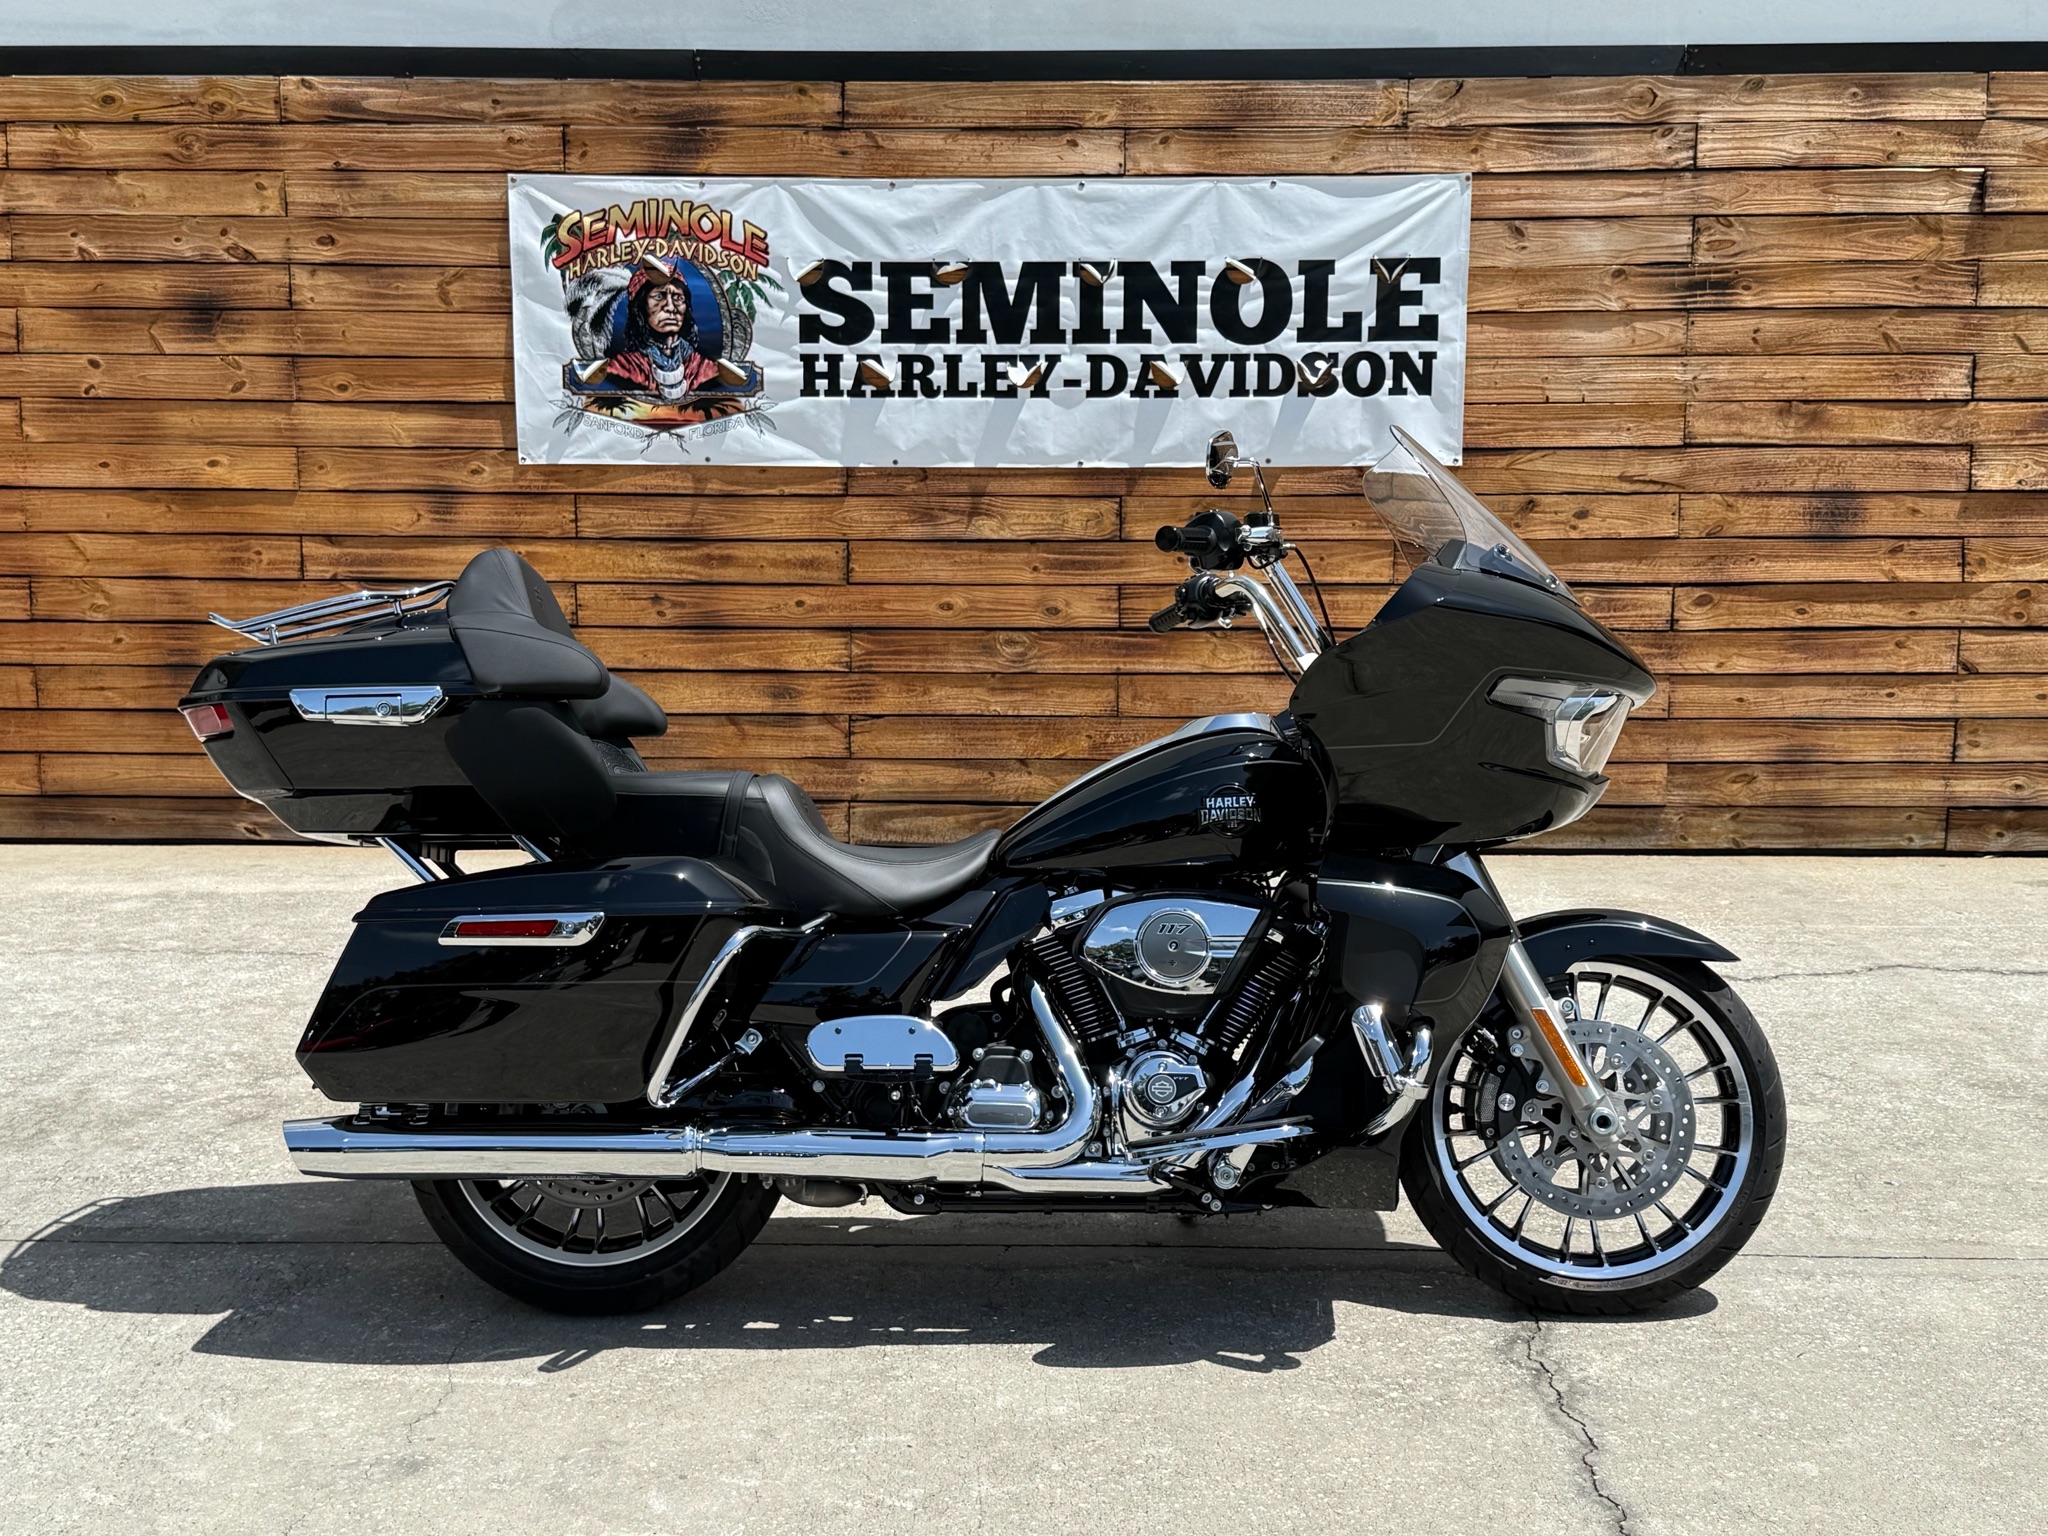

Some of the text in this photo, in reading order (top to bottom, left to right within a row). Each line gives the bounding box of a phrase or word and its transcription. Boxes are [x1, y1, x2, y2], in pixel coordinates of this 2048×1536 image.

[552, 199, 770, 269] SEMINOLE
[568, 238, 759, 281] HARLEY-DAVIDSON
[799, 257, 1441, 346] SEMINOLE
[799, 351, 1437, 399] HARLEY-DAVIDSON
[583, 415, 744, 442] SANFORD, FLORIDA
[1200, 808, 1261, 825] DAVIDSON
[1157, 923, 1193, 935] 117
